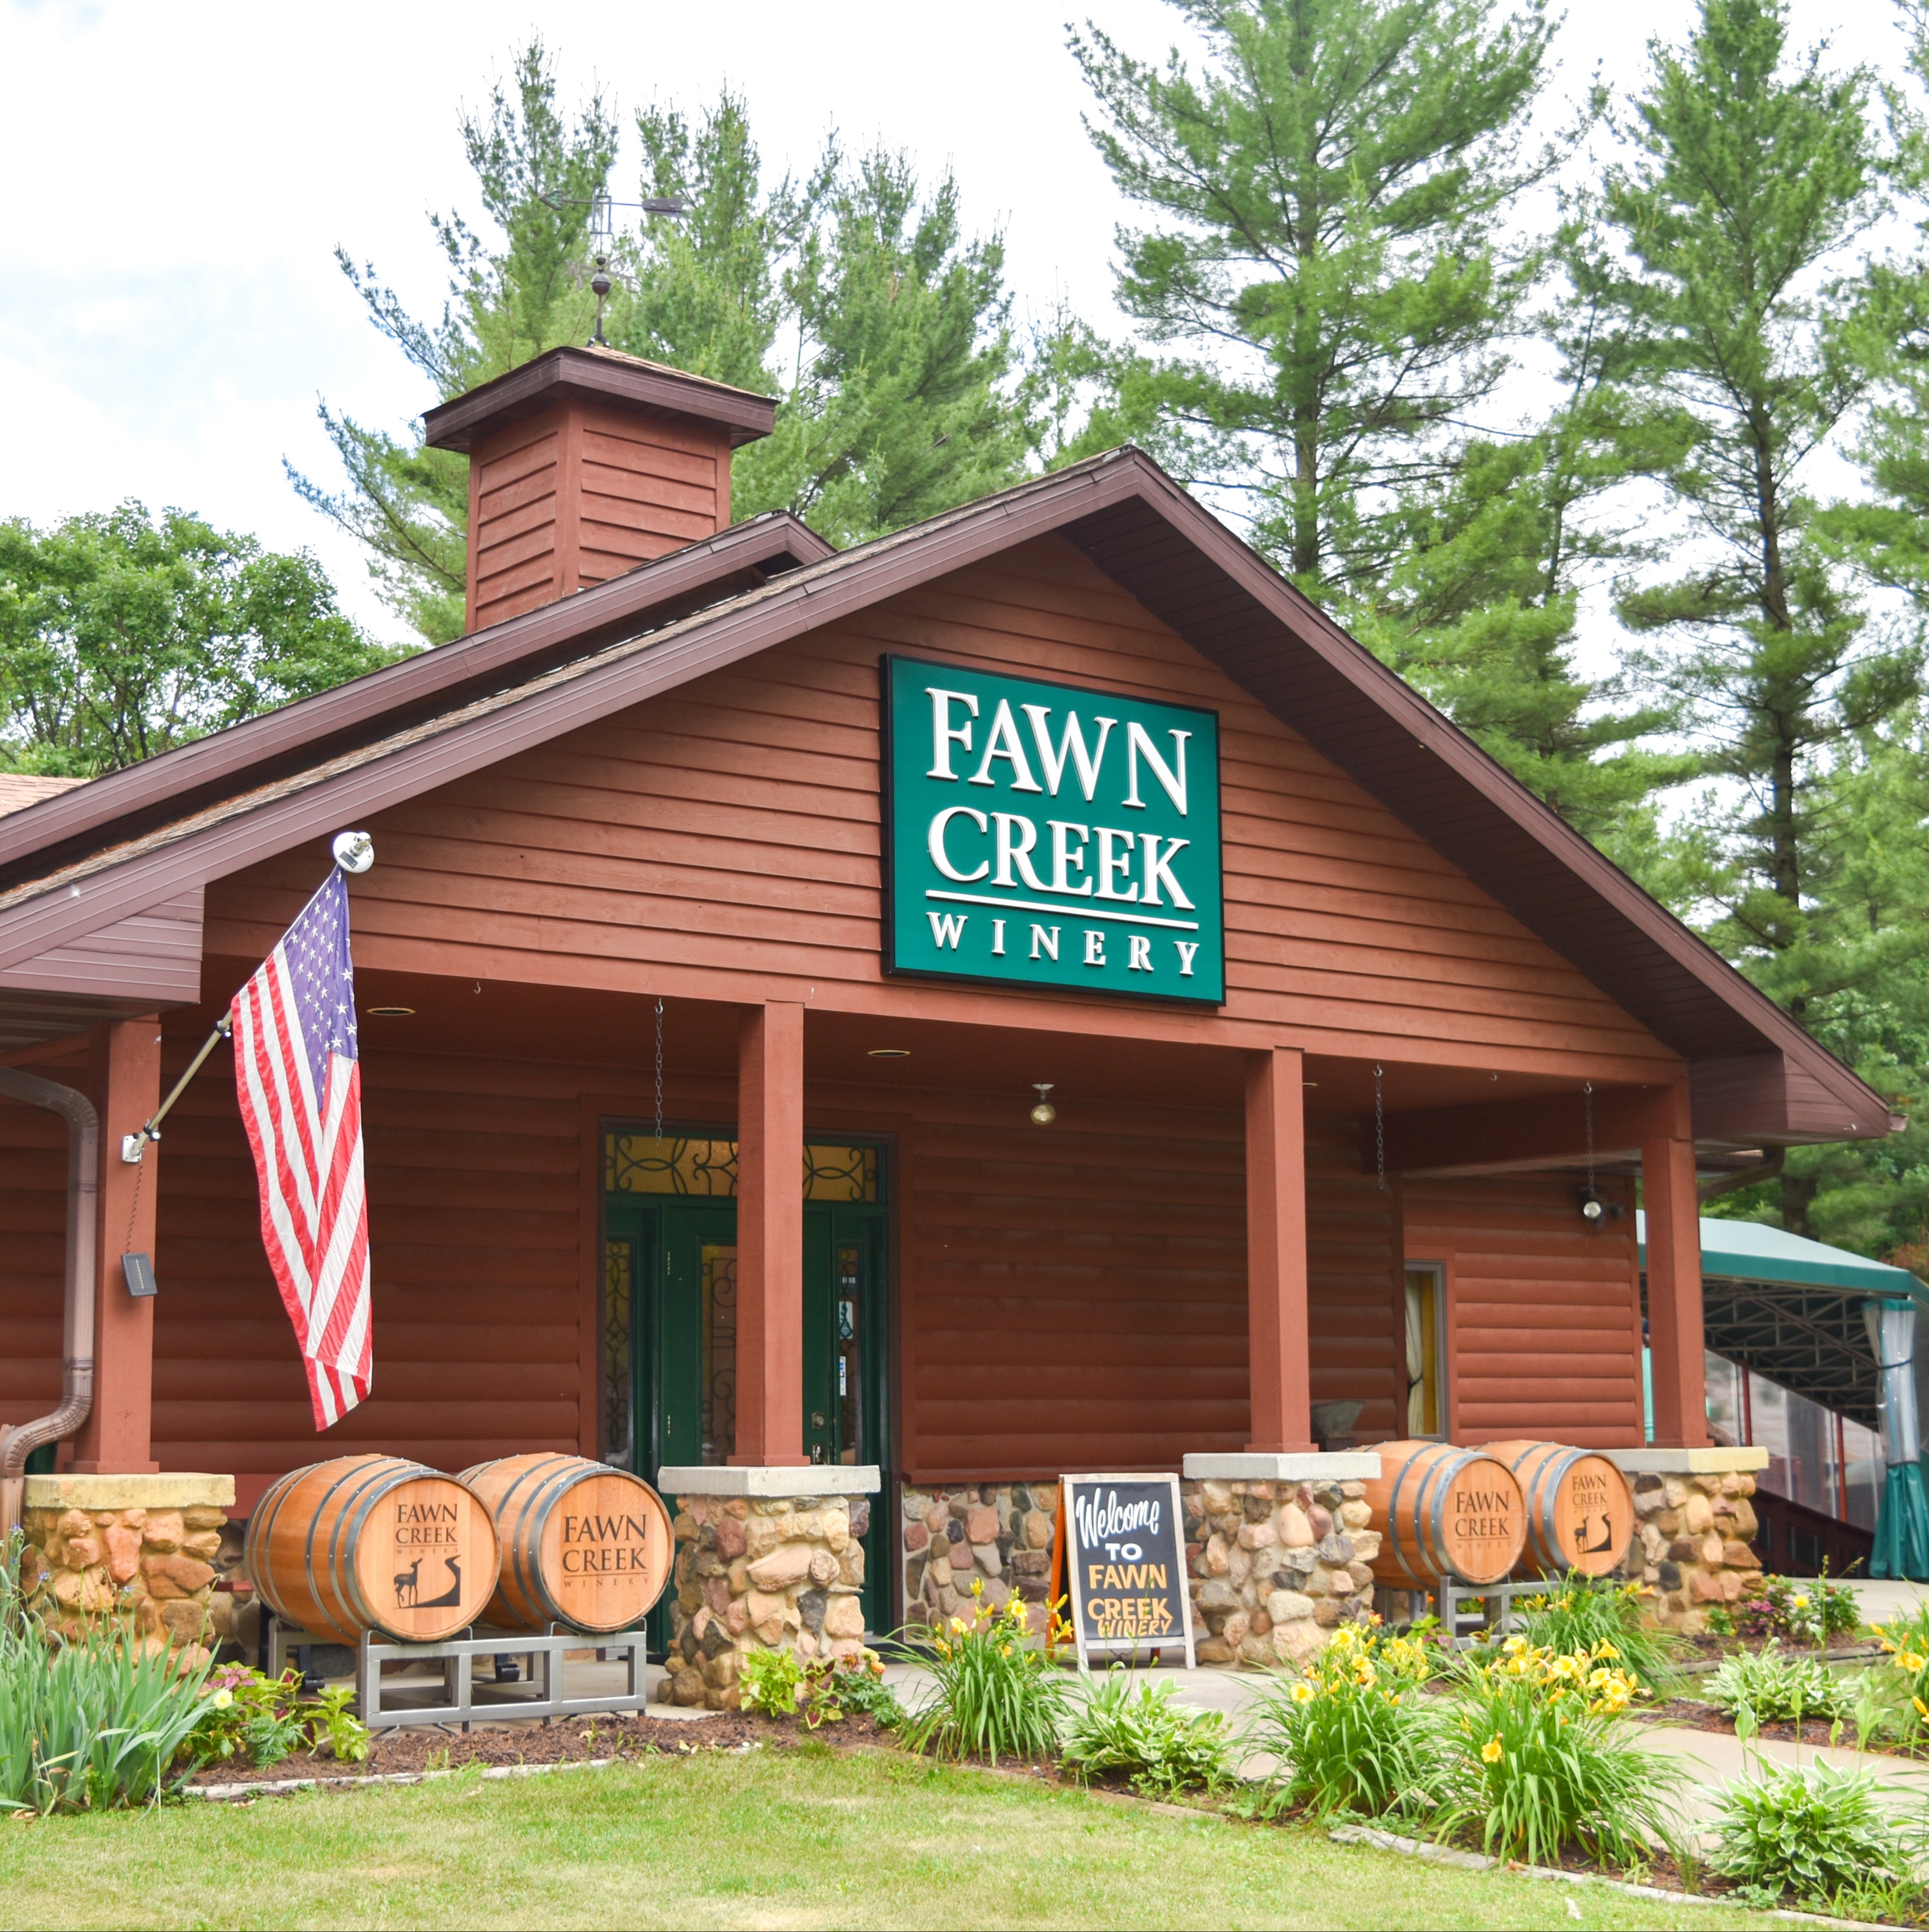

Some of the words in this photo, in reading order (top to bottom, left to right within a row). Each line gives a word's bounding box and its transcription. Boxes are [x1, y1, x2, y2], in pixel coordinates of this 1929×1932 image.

[925, 687, 1192, 815] FAWN
[927, 806, 1196, 909] CREEK
[925, 912, 1199, 975] WINERY
[1572, 1473, 1606, 1491] FAWN
[1456, 1491, 1509, 1513] FAWN
[1572, 1492, 1607, 1506] CREEK
[397, 1503, 458, 1523] FAWN
[1075, 1487, 1160, 1549] Welcome
[396, 1526, 457, 1543] CREEK
[563, 1514, 648, 1543] FAWN
[1455, 1518, 1509, 1536] CREEK
[563, 1548, 648, 1572] CREEK
[1105, 1543, 1143, 1561] TO
[564, 1577, 649, 1588] WINERY
[1088, 1563, 1167, 1589] FAWN
[1087, 1598, 1173, 1620] CREEK
[1097, 1619, 1172, 1638] WINERY
